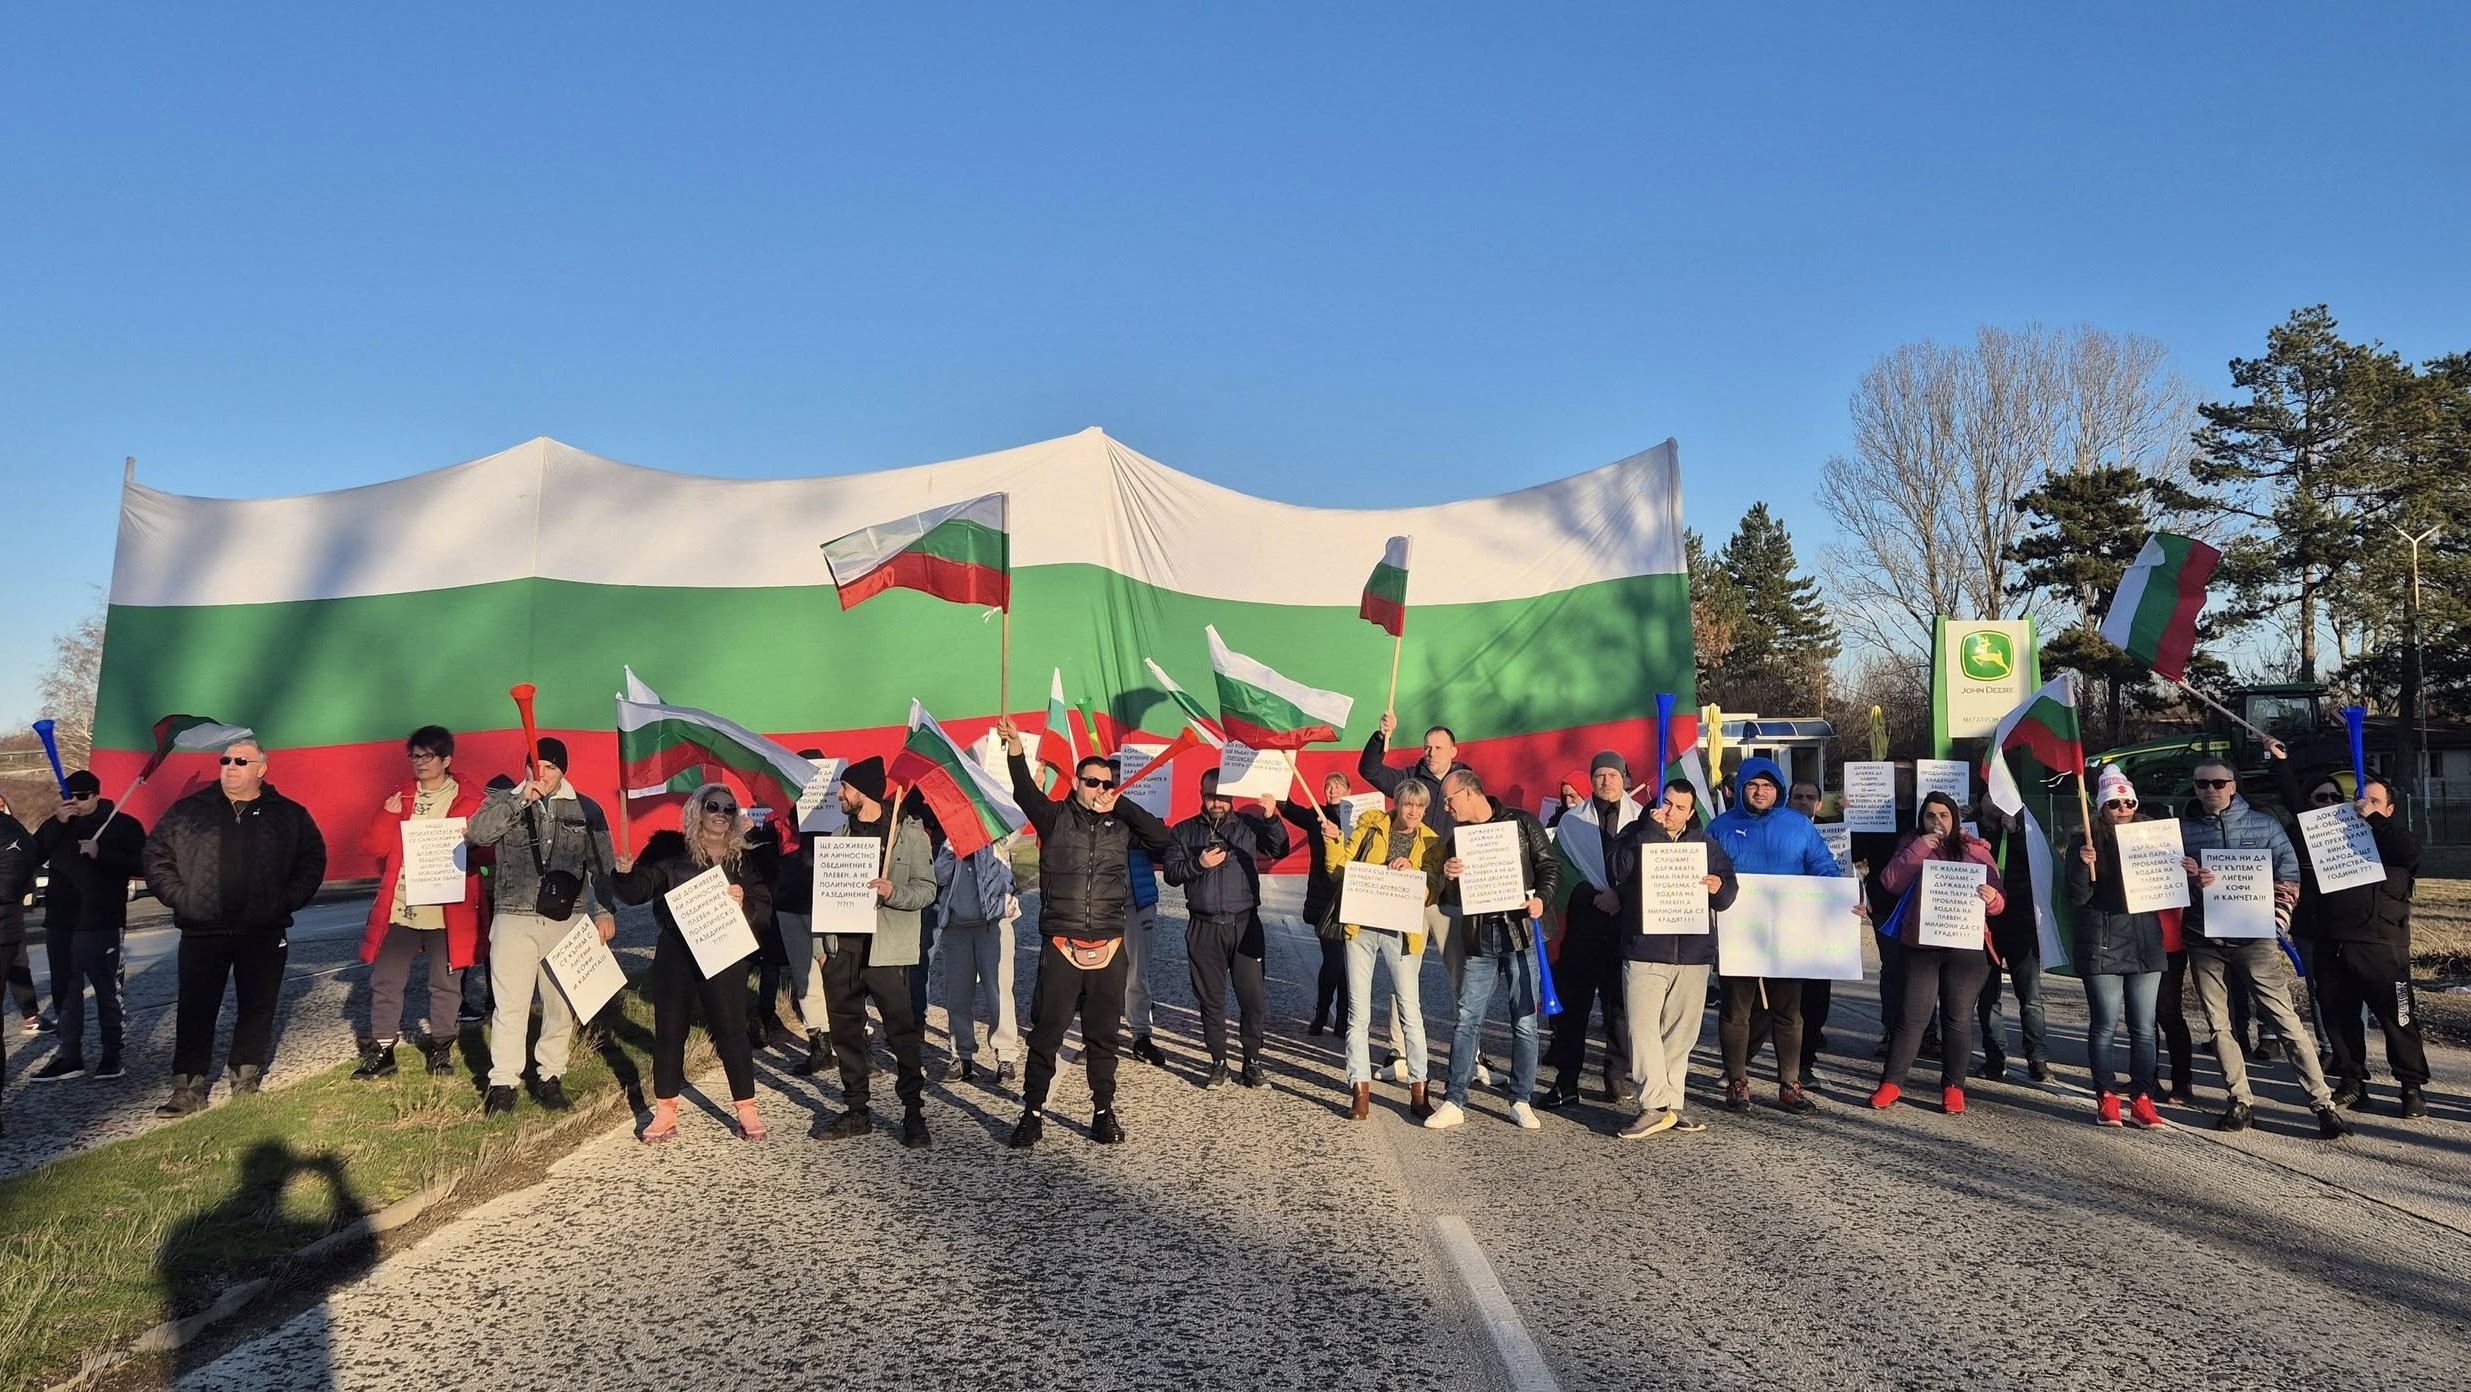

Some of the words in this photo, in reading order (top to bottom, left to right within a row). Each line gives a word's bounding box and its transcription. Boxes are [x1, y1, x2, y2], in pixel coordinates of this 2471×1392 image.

[1985, 686, 2015, 694] DEERE
[2316, 808, 2347, 821] ДОКОГА
[2309, 822, 2365, 840] МИНИСТЕРСТВА
[2311, 841, 2323, 849] ЩЕ
[2324, 830, 2368, 845] ПРЕХВЪРЛЯТ
[2128, 852, 2148, 860] НЯМА
[2149, 850, 2167, 858] ПАРИ
[2206, 854, 2237, 862] ПИСНА
[2252, 854, 2267, 862] ДА
[2326, 851, 2358, 863] НАРОДА
[2359, 847, 2371, 855] ЩЕ
[2132, 859, 2168, 868] ПРОБЛЕМА
[2211, 864, 2222, 872] СЕ
[2256, 864, 2263, 872] С
[2322, 858, 2365, 872] МИЗЕРСТВА
[1934, 873, 1969, 881] СЛУШАМЕ
[2136, 867, 2162, 876] ВОДАТА
[2327, 869, 2359, 880] ГОДИНИ
[2360, 865, 2372, 873] ???
[671, 894, 682, 903] ЩЕ
[683, 873, 719, 897] ДОЖИВЕЕМ
[1934, 881, 1974, 890] ДЪРЖАВАТА
[675, 903, 685, 912] ЛИ
[685, 881, 724, 906] ЛИЧНОСТНО
[1932, 897, 1968, 905] ПРОБЛЕМА
[680, 894, 721, 920] ОБЕДИНЕНИЕ
[719, 901, 728, 909] НЕ
[1934, 905, 1961, 913] ВОДАТА
[689, 907, 735, 938] ПОЛИТИЧЕСКО
[1924, 921, 1958, 929] МИЛИОНИ
[694, 916, 738, 945] РАЗЕДИНЕНИЕ
[552, 941, 574, 962] ПИСНА
[573, 931, 582, 942] НИ
[581, 922, 591, 934] ДА
[560, 957, 569, 967] СЕ
[568, 938, 587, 959] КЪПЕМ
[570, 946, 592, 969] ЛИГЕНИ
[577, 955, 593, 974] КОФИ
